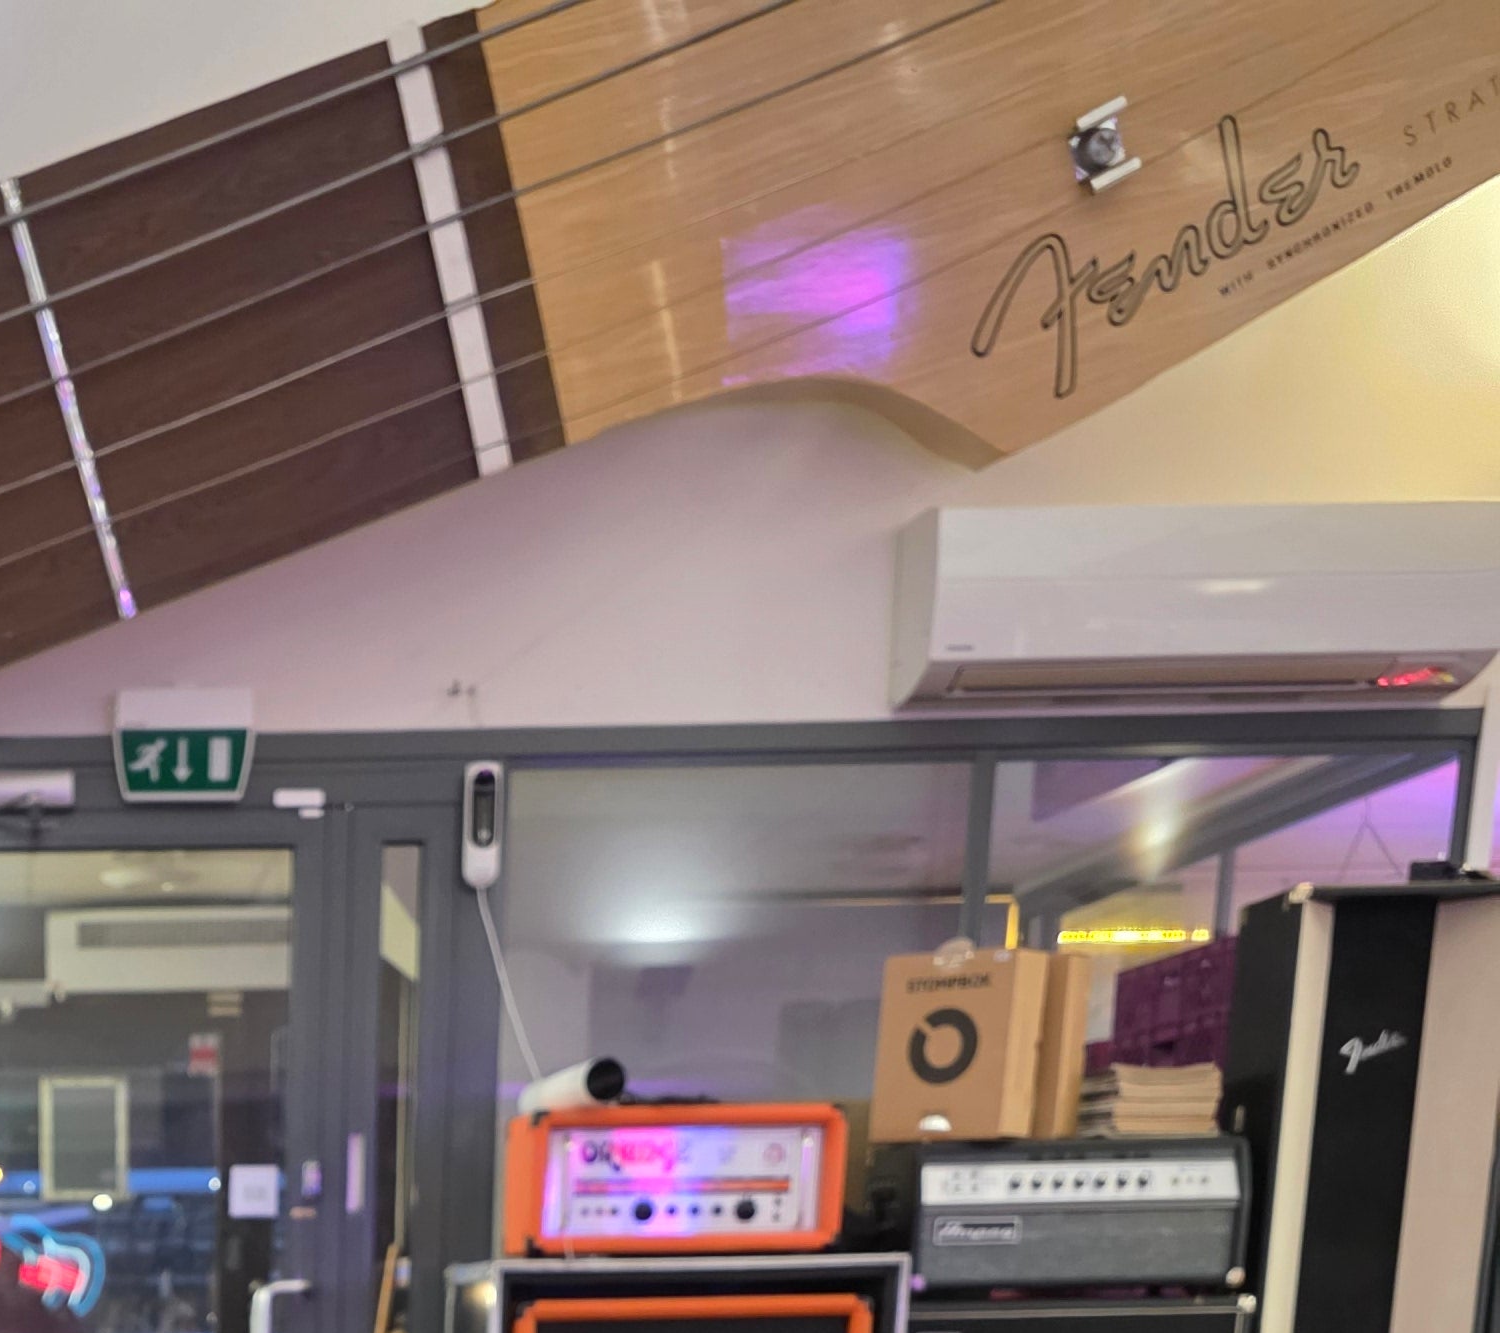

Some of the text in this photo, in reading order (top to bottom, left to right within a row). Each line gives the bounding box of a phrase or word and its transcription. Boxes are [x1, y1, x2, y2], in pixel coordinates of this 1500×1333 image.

[970, 114, 1360, 399] Fender
[1266, 201, 1375, 270] SYNCHRONIZED
[1385, 155, 1454, 201] TREMOLO
